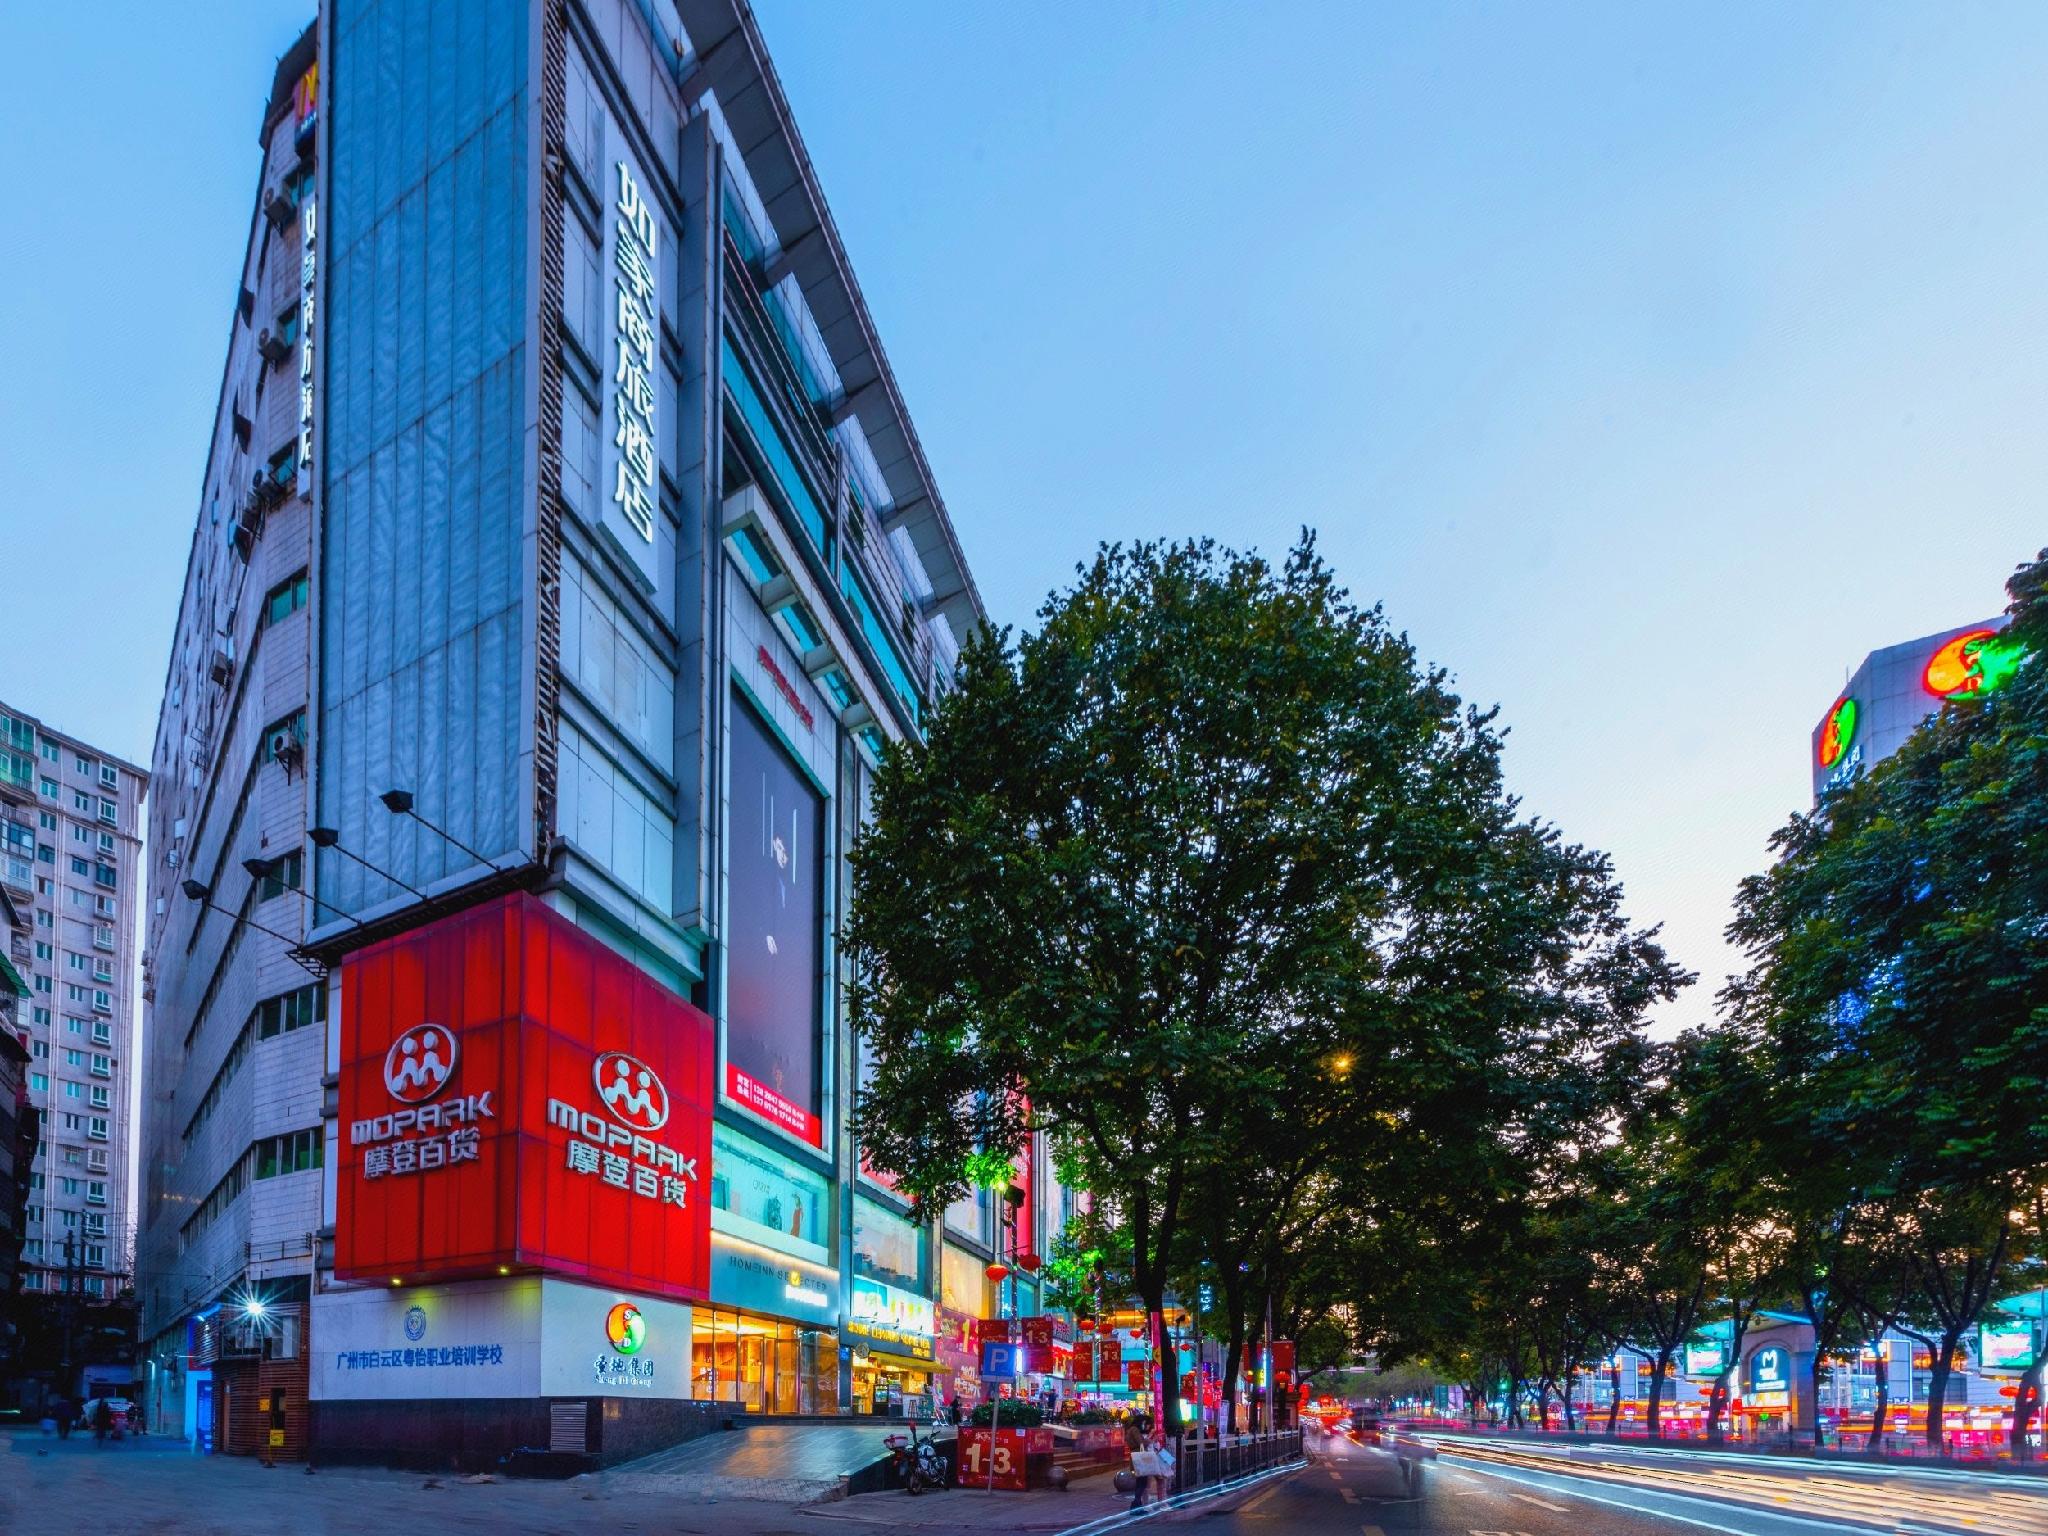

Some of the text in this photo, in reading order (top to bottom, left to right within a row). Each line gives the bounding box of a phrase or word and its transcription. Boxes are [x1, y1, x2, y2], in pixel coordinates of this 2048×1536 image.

[615, 159, 656, 544] 如家商旅酒店
[351, 1091, 495, 1145] MOPARK
[548, 1098, 698, 1181] MOPARK
[364, 1126, 480, 1180] 摩登百货
[566, 1139, 687, 1208] 摩登百货
[777, 1270, 827, 1292] SECTED
[337, 1344, 503, 1370] 广州市白云区粤怡职业培训学校
[990, 1348, 1008, 1372] P
